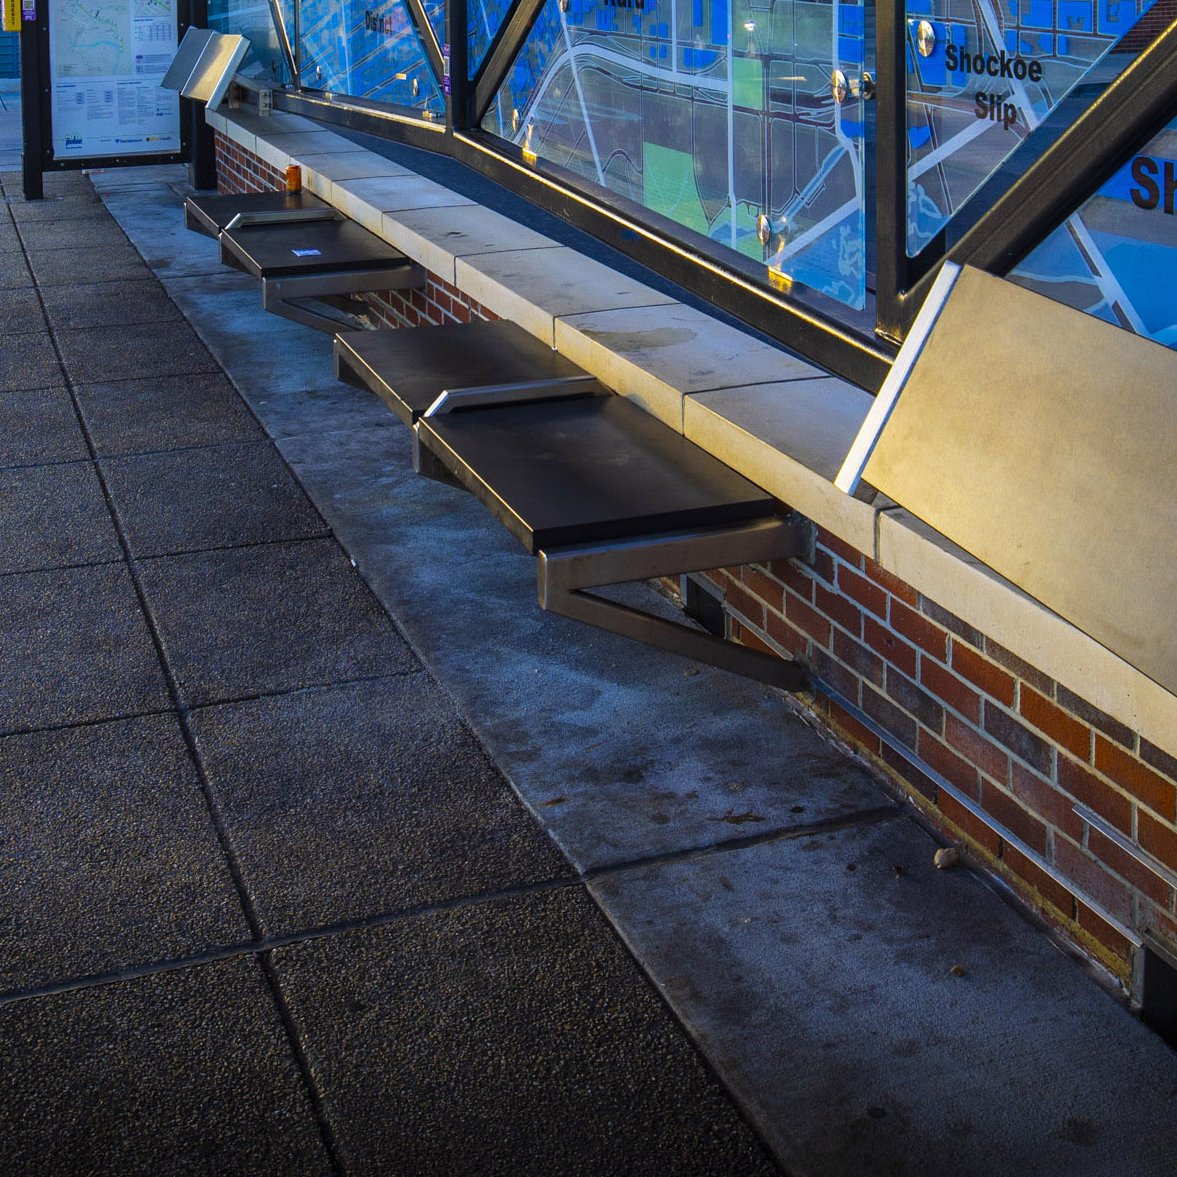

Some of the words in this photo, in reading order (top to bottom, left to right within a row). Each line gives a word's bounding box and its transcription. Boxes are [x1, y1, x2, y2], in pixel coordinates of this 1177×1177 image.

[365, 10, 393, 35] District
[945, 43, 1043, 82] Shockoe
[974, 91, 1017, 130] Slip
